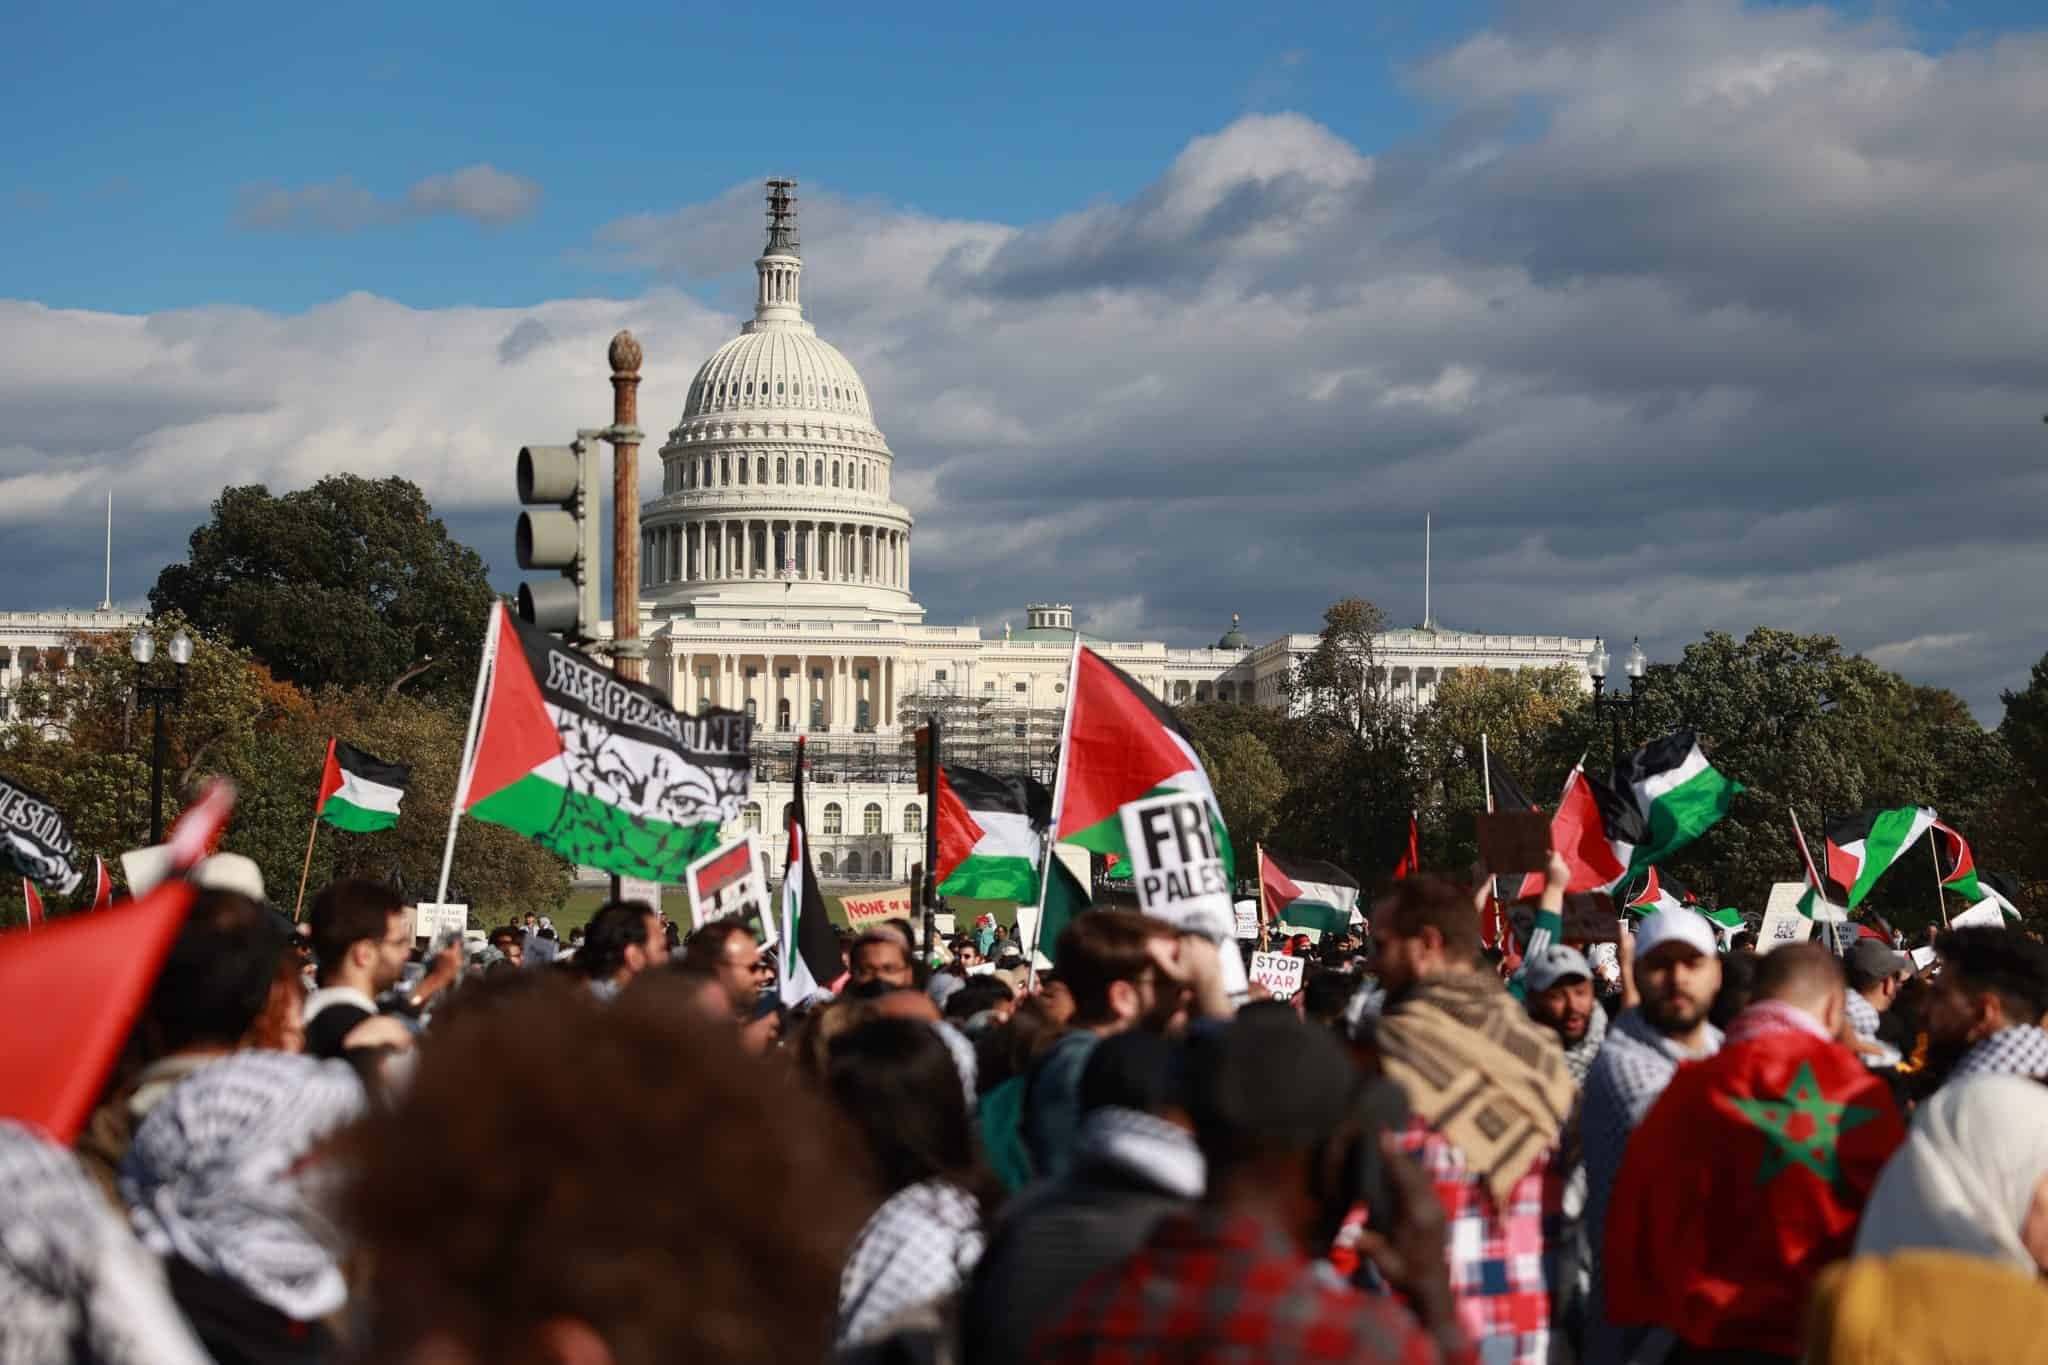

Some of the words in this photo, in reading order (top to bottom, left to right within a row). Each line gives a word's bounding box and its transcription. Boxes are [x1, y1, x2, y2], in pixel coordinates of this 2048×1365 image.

[546, 650, 606, 713] FREE
[846, 899, 888, 919] NONE
[1256, 955, 1300, 973] STOP
[1256, 971, 1295, 988] WAR
